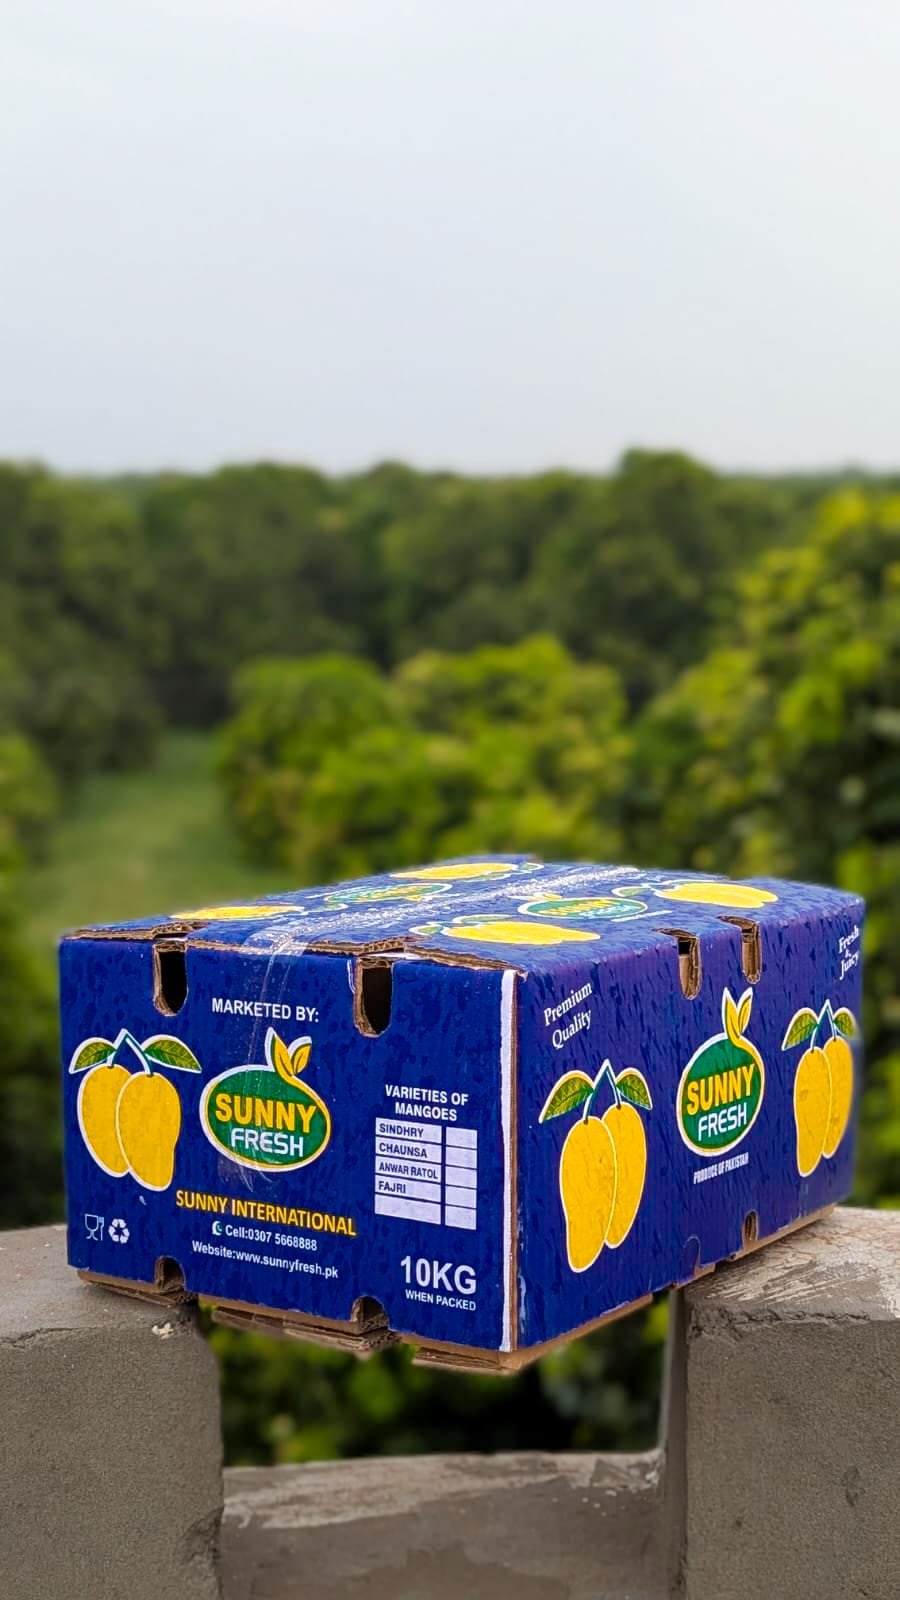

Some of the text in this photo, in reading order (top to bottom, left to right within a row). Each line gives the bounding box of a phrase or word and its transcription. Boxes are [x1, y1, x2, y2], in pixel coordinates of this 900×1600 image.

[838, 924, 859, 954] Fresh
[839, 950, 859, 980] Juicy
[212, 998, 319, 1023] MARKETED BY:
[543, 982, 593, 1027] Premium
[552, 1009, 592, 1050] Quality
[385, 1084, 469, 1106] VARIETIES OF
[686, 1063, 756, 1116] SUNNY
[215, 1093, 317, 1133] SUNNY
[395, 1101, 458, 1122] MANGOES
[697, 1102, 748, 1141] FRESH
[231, 1127, 304, 1158] FRESH
[379, 1123, 424, 1138] SINDHRY
[379, 1142, 428, 1159] CHAUNSA
[379, 1162, 439, 1180] ANWAR RATOL
[693, 1151, 749, 1185] PRODUCE OF PAKISTAN
[378, 1180, 406, 1194] FAJRI
[176, 1189, 357, 1236] SUNNY INTERNATIONAL
[225, 1224, 318, 1251] Cell:0307 5668888
[192, 1240, 339, 1279] Website:www.sunnyfresh.pk
[400, 1255, 477, 1295] 10KG
[405, 1289, 477, 1312] WHEN PACKED
